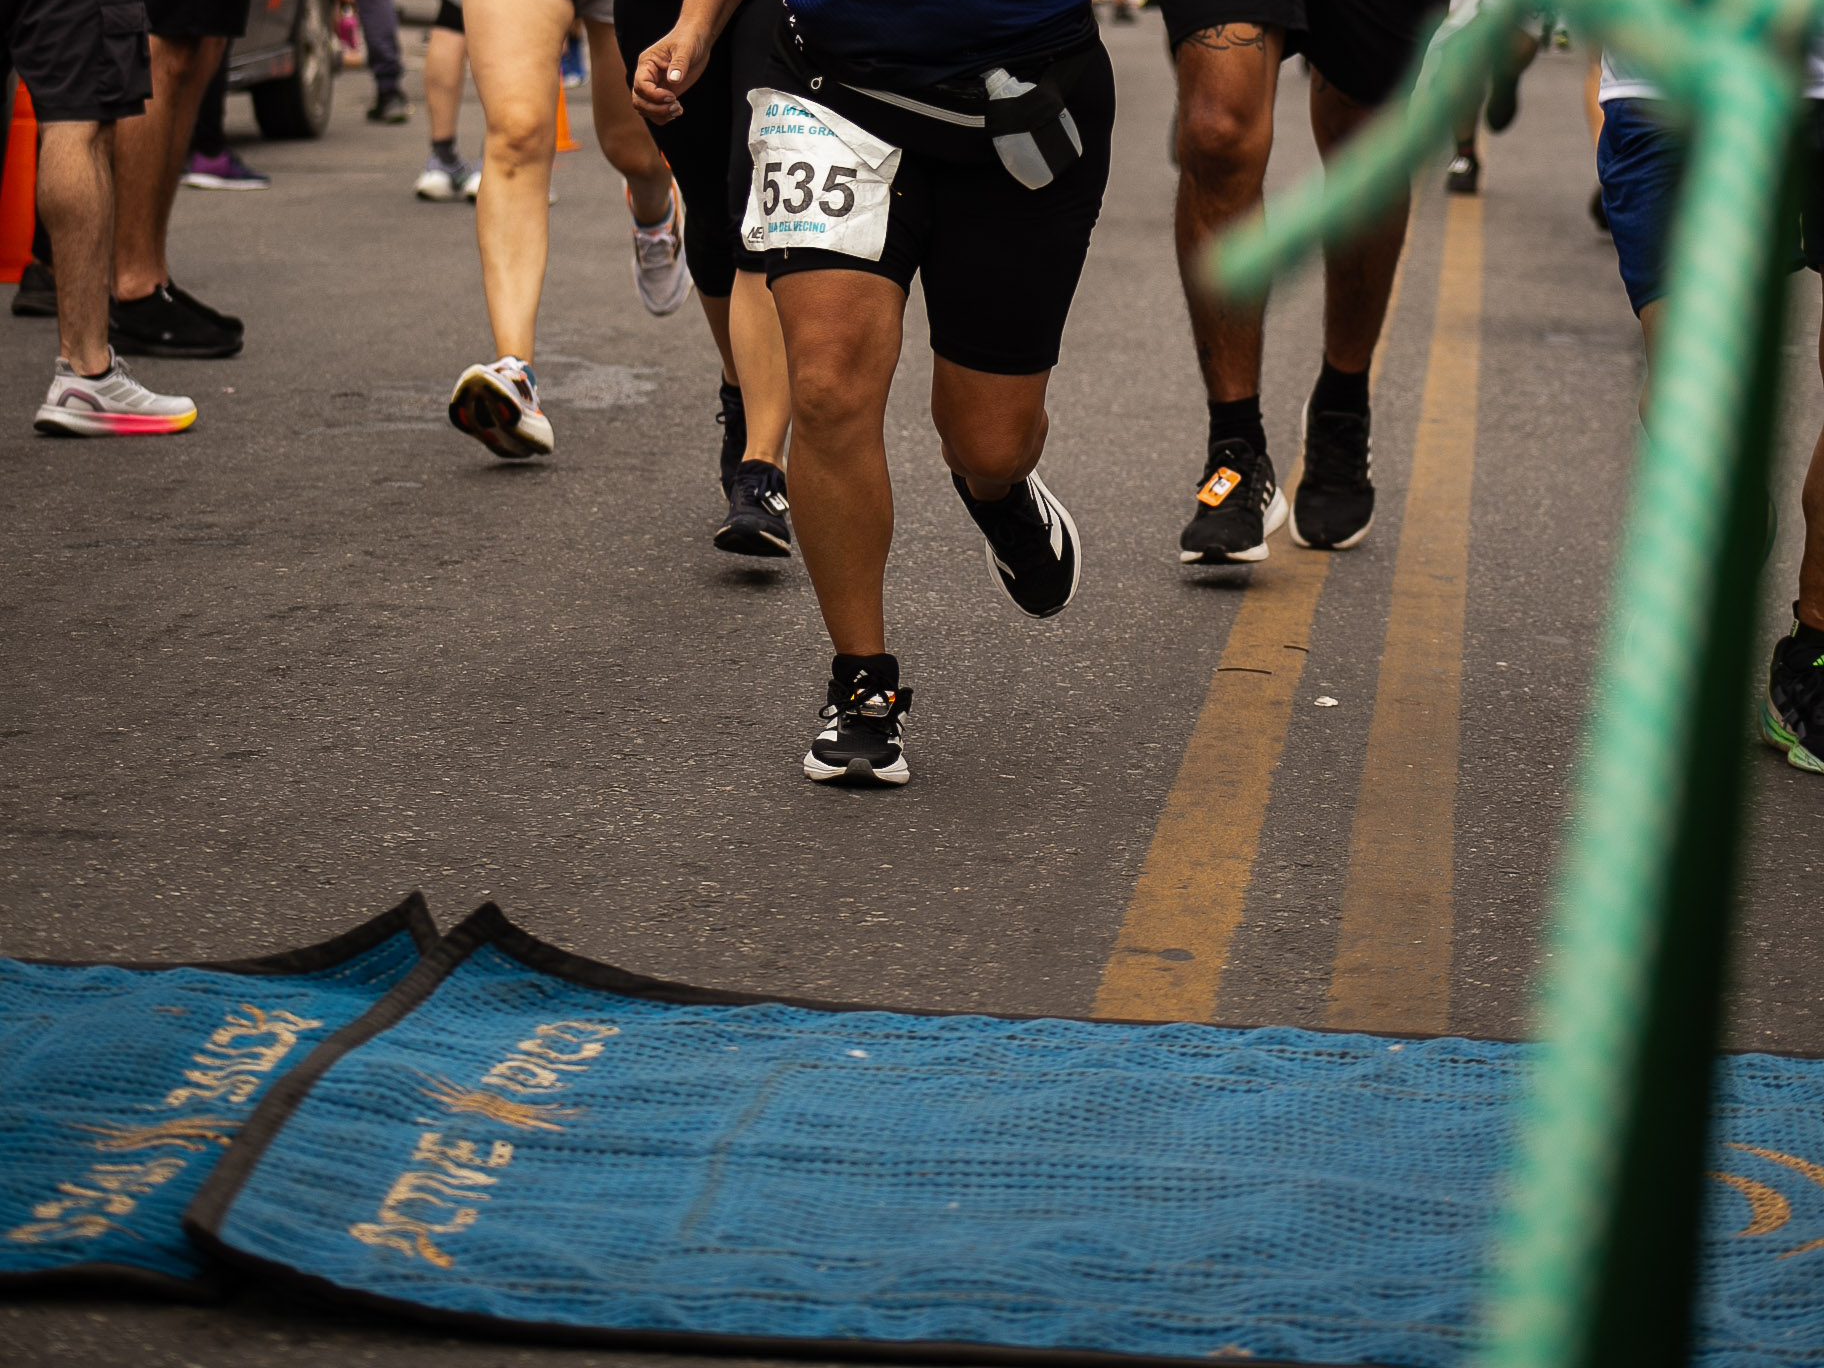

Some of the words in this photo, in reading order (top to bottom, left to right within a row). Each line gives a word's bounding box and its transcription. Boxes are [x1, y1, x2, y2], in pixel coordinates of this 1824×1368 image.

[766, 104, 779, 118] 40
[760, 125, 805, 137] EMPALME
[763, 162, 857, 218] 535
[793, 220, 826, 233] VECINO
